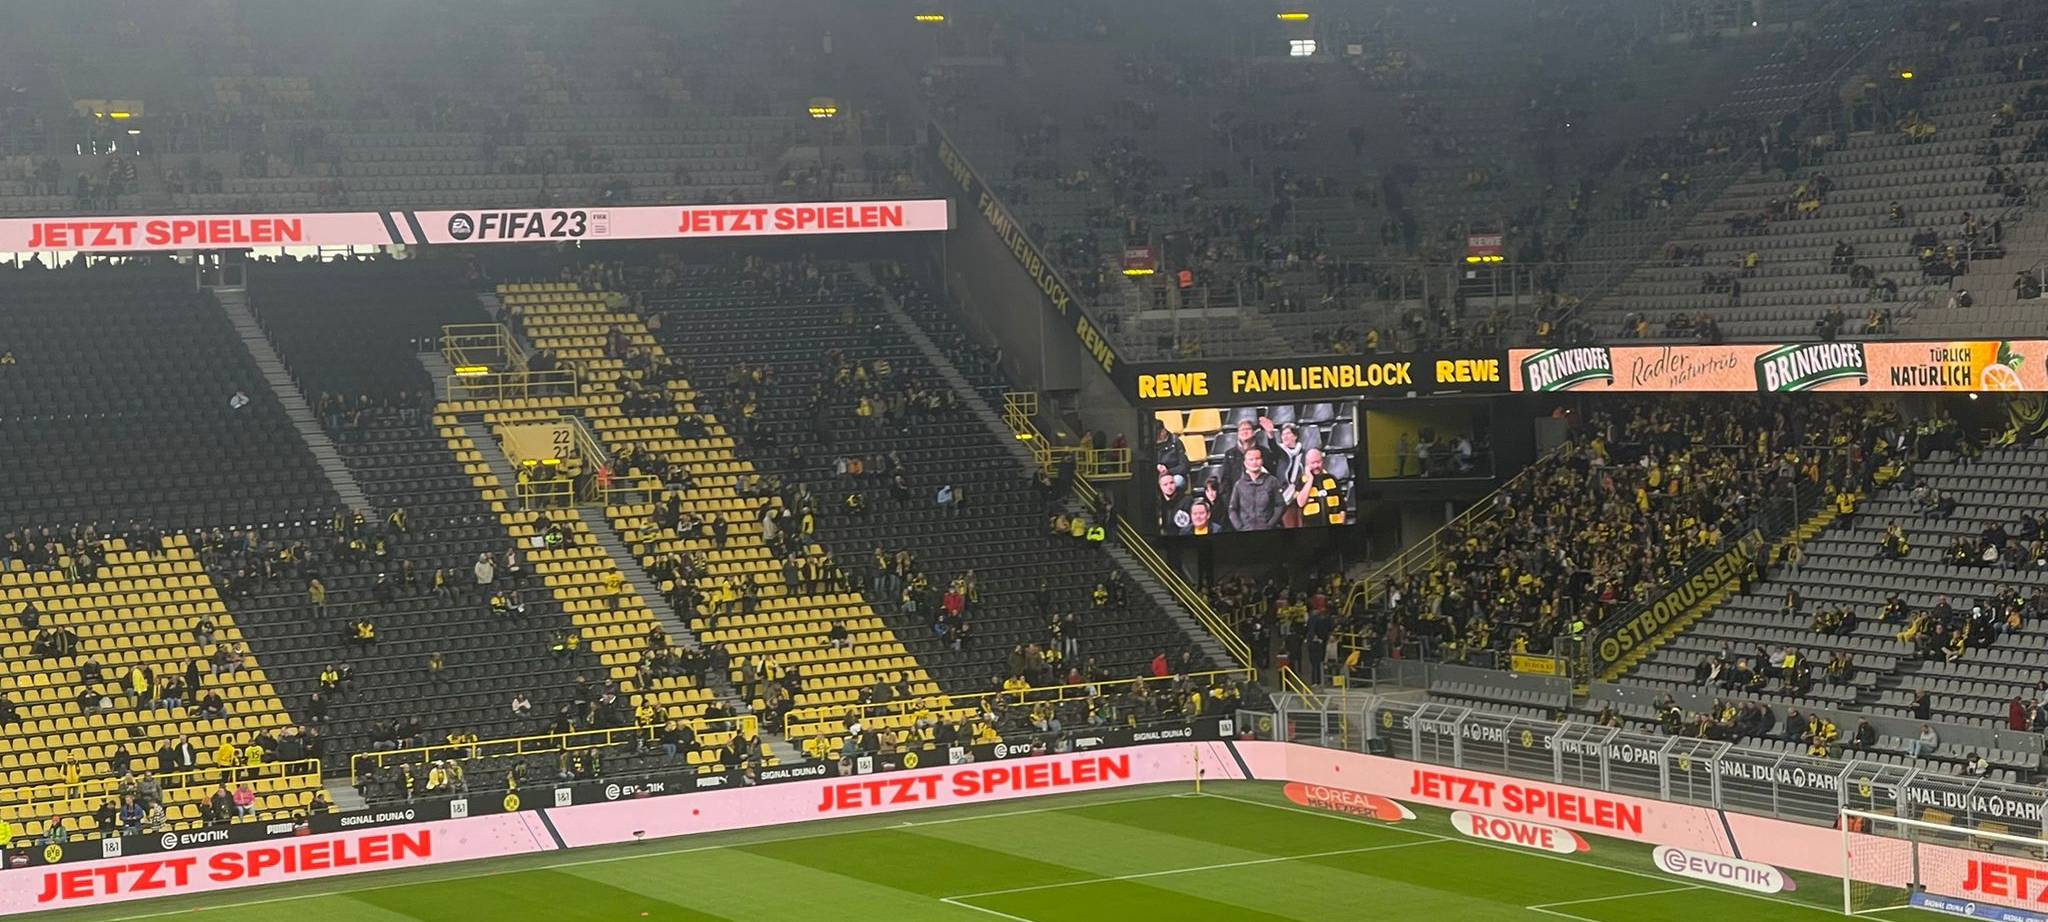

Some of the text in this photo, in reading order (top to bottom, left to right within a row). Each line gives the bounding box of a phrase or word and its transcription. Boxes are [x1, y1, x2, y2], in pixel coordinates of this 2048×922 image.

[938, 140, 972, 192] REWE
[28, 218, 302, 248] JETZT SPIELEN
[478, 210, 588, 239] FIFA 23
[678, 205, 903, 233] JETZT SPIELEN
[979, 192, 1071, 316] FAMILIENBLOCK
[1076, 316, 1117, 373] REWE
[1930, 348, 1971, 362] TÜRLICH
[1138, 359, 1499, 398] REWE FAMILIENBLOCK REWE
[1631, 346, 1689, 388] Radler
[1669, 351, 1738, 388] naturtrüb
[1891, 364, 1971, 386] NATÜRLICH
[553, 430, 570, 444] 22
[553, 445, 568, 459] 21
[1133, 729, 1184, 741] SIGNAL IDUNA
[1544, 735, 1585, 754] SNAL
[1634, 748, 1660, 765] PAR
[761, 767, 817, 780] SIGNAL IDUNA
[818, 754, 1131, 812] JETZT SPIELEN
[453, 803, 466, 813] 1&1
[1411, 769, 1643, 834] JETZT SPIELEN
[340, 811, 405, 826] SIGNAL IDUNA
[1470, 814, 1555, 849] ROWE
[46, 846, 61, 857] BVB
[105, 842, 119, 852] 1&1
[181, 830, 229, 844] EVONIK
[38, 829, 431, 903] JETZT SPIELEN
[1689, 858, 1772, 887] EVONIK
